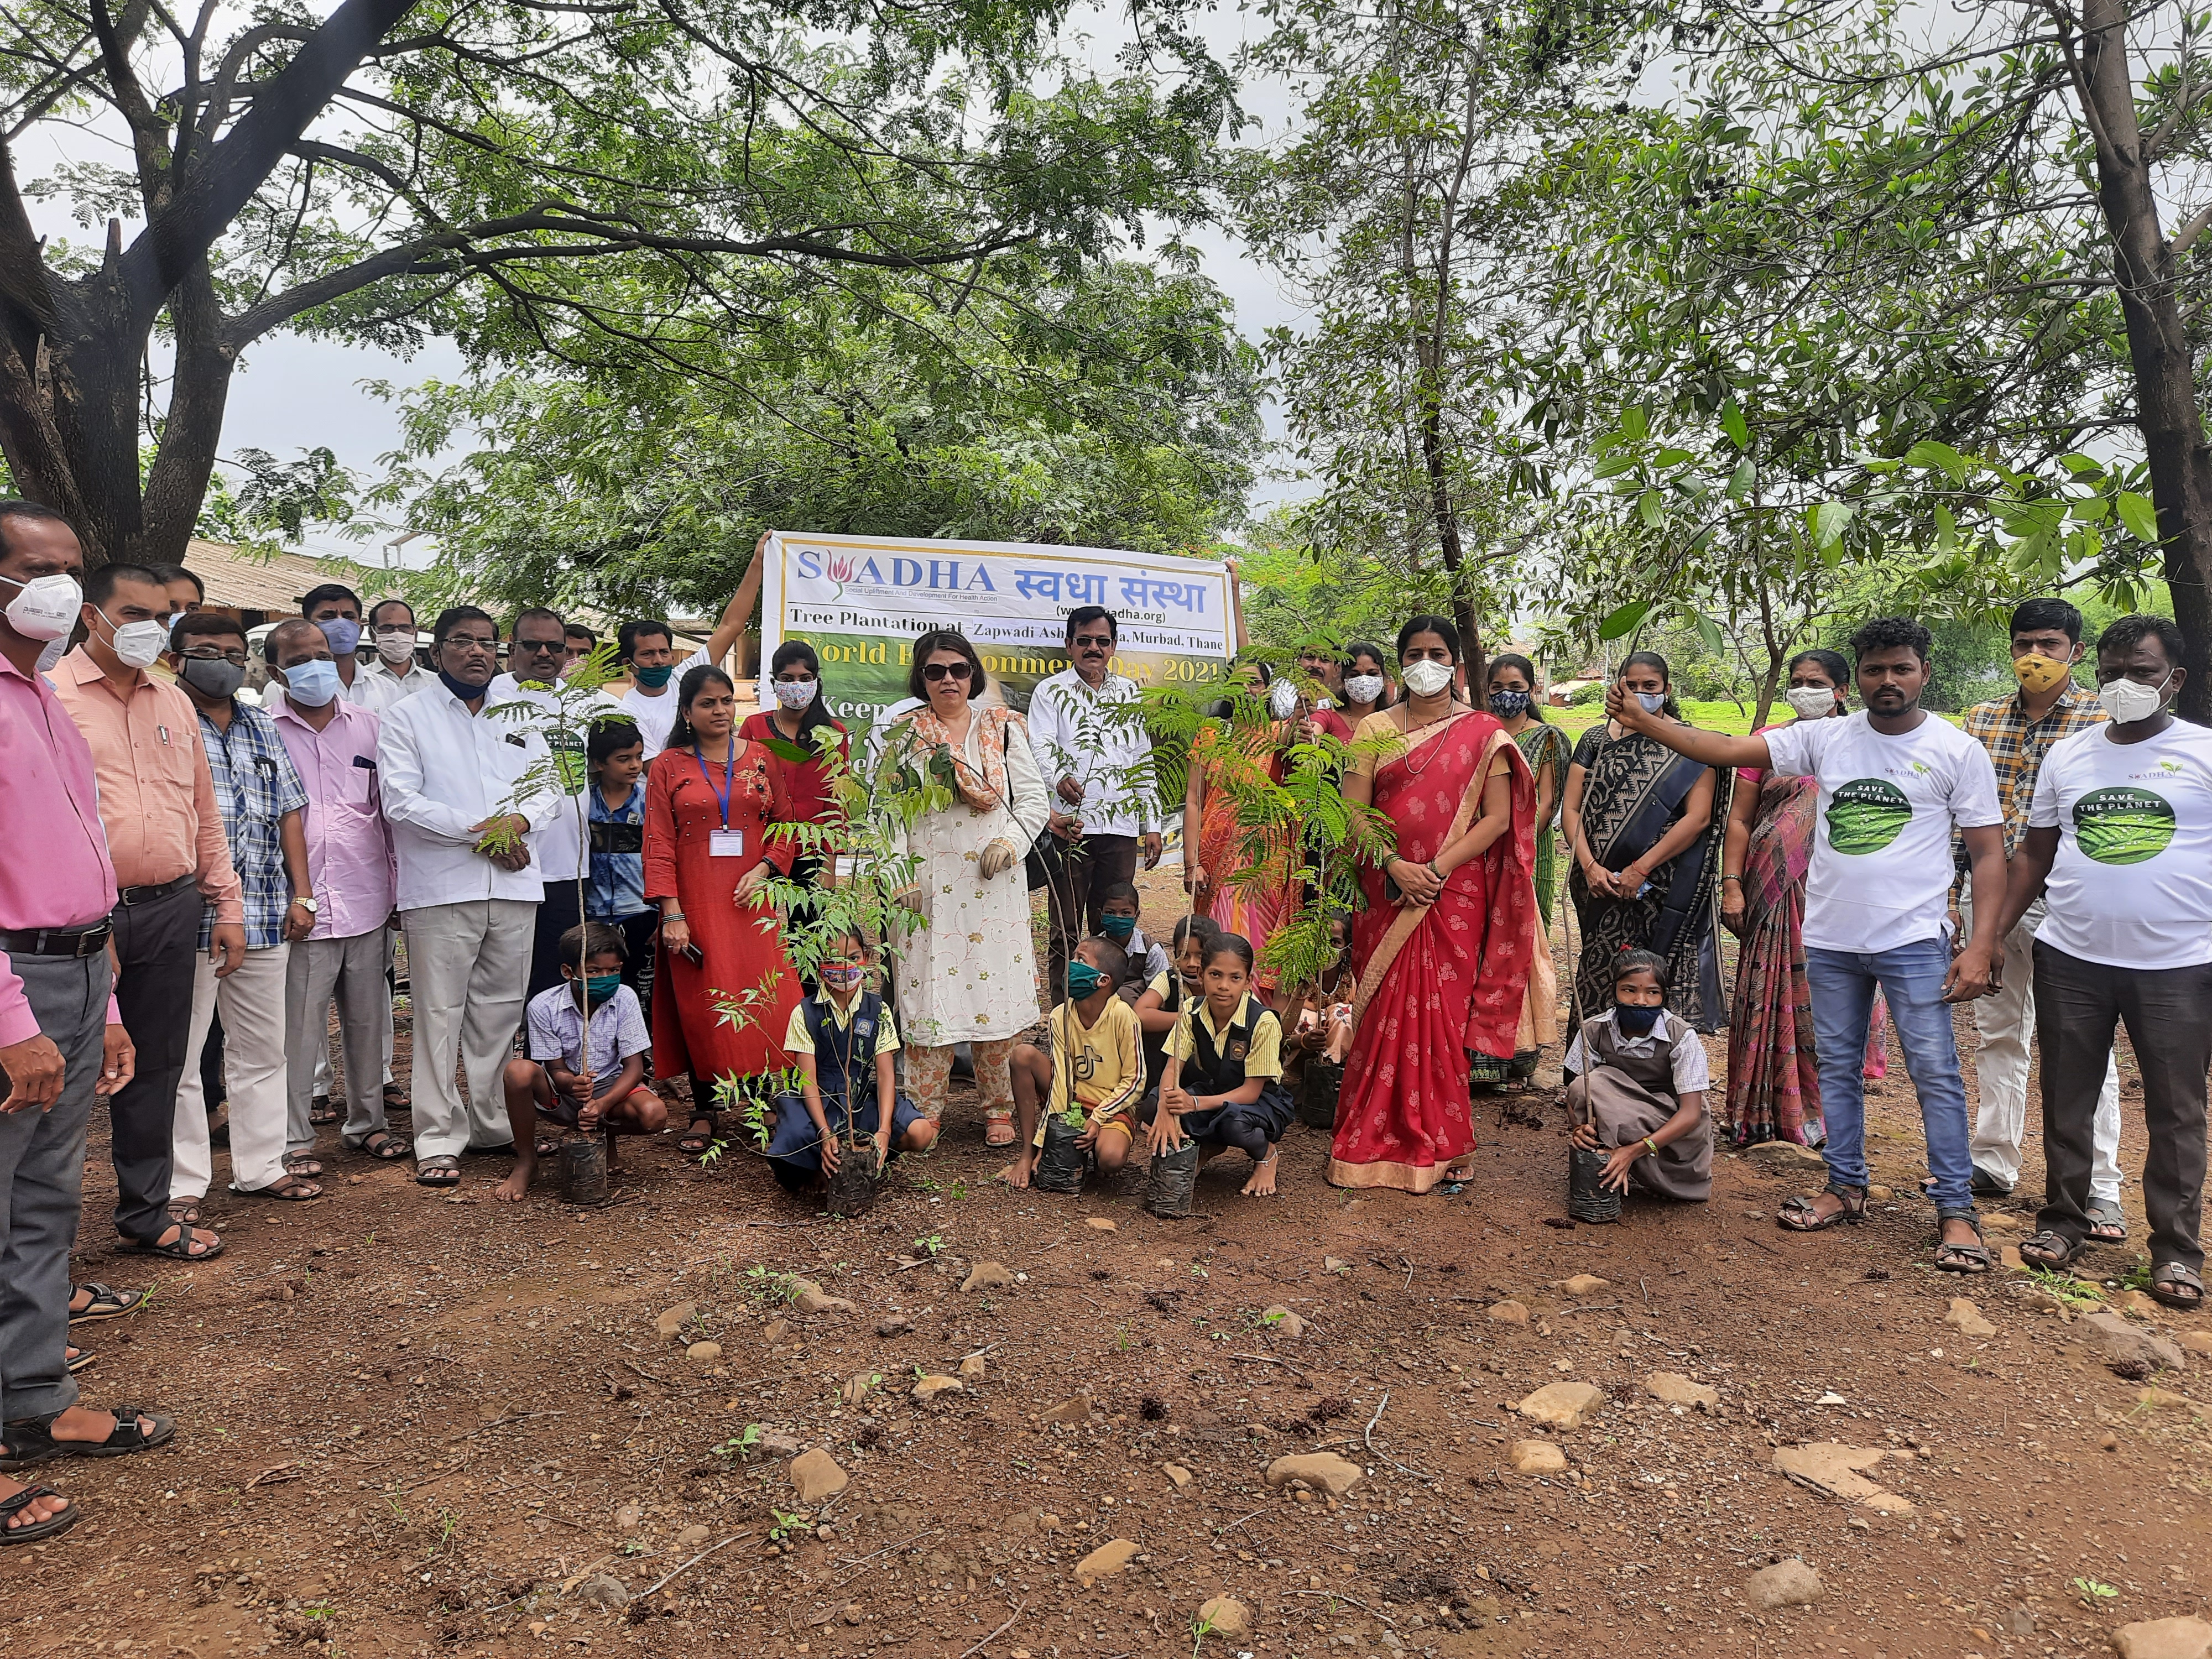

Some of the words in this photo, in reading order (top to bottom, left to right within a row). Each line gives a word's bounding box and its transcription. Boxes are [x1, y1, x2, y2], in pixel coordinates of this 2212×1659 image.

[864, 587, 894, 596] Upliftment
[908, 591, 947, 599] Development
[1014, 569, 1108, 604] स्वधा
[1119, 570, 1207, 613] संस्था
[790, 608, 833, 624] Tree
[839, 611, 939, 632] Plantation
[1132, 631, 1185, 648] Murbad,
[1187, 636, 1223, 650] Thane
[1108, 656, 1156, 681] Day
[1164, 659, 1217, 682] 2021
[1856, 785, 1885, 794] SAVE
[1860, 793, 1904, 805] PLANET
[2079, 804, 2103, 812] THE
[2108, 800, 2162, 811] PLANET
